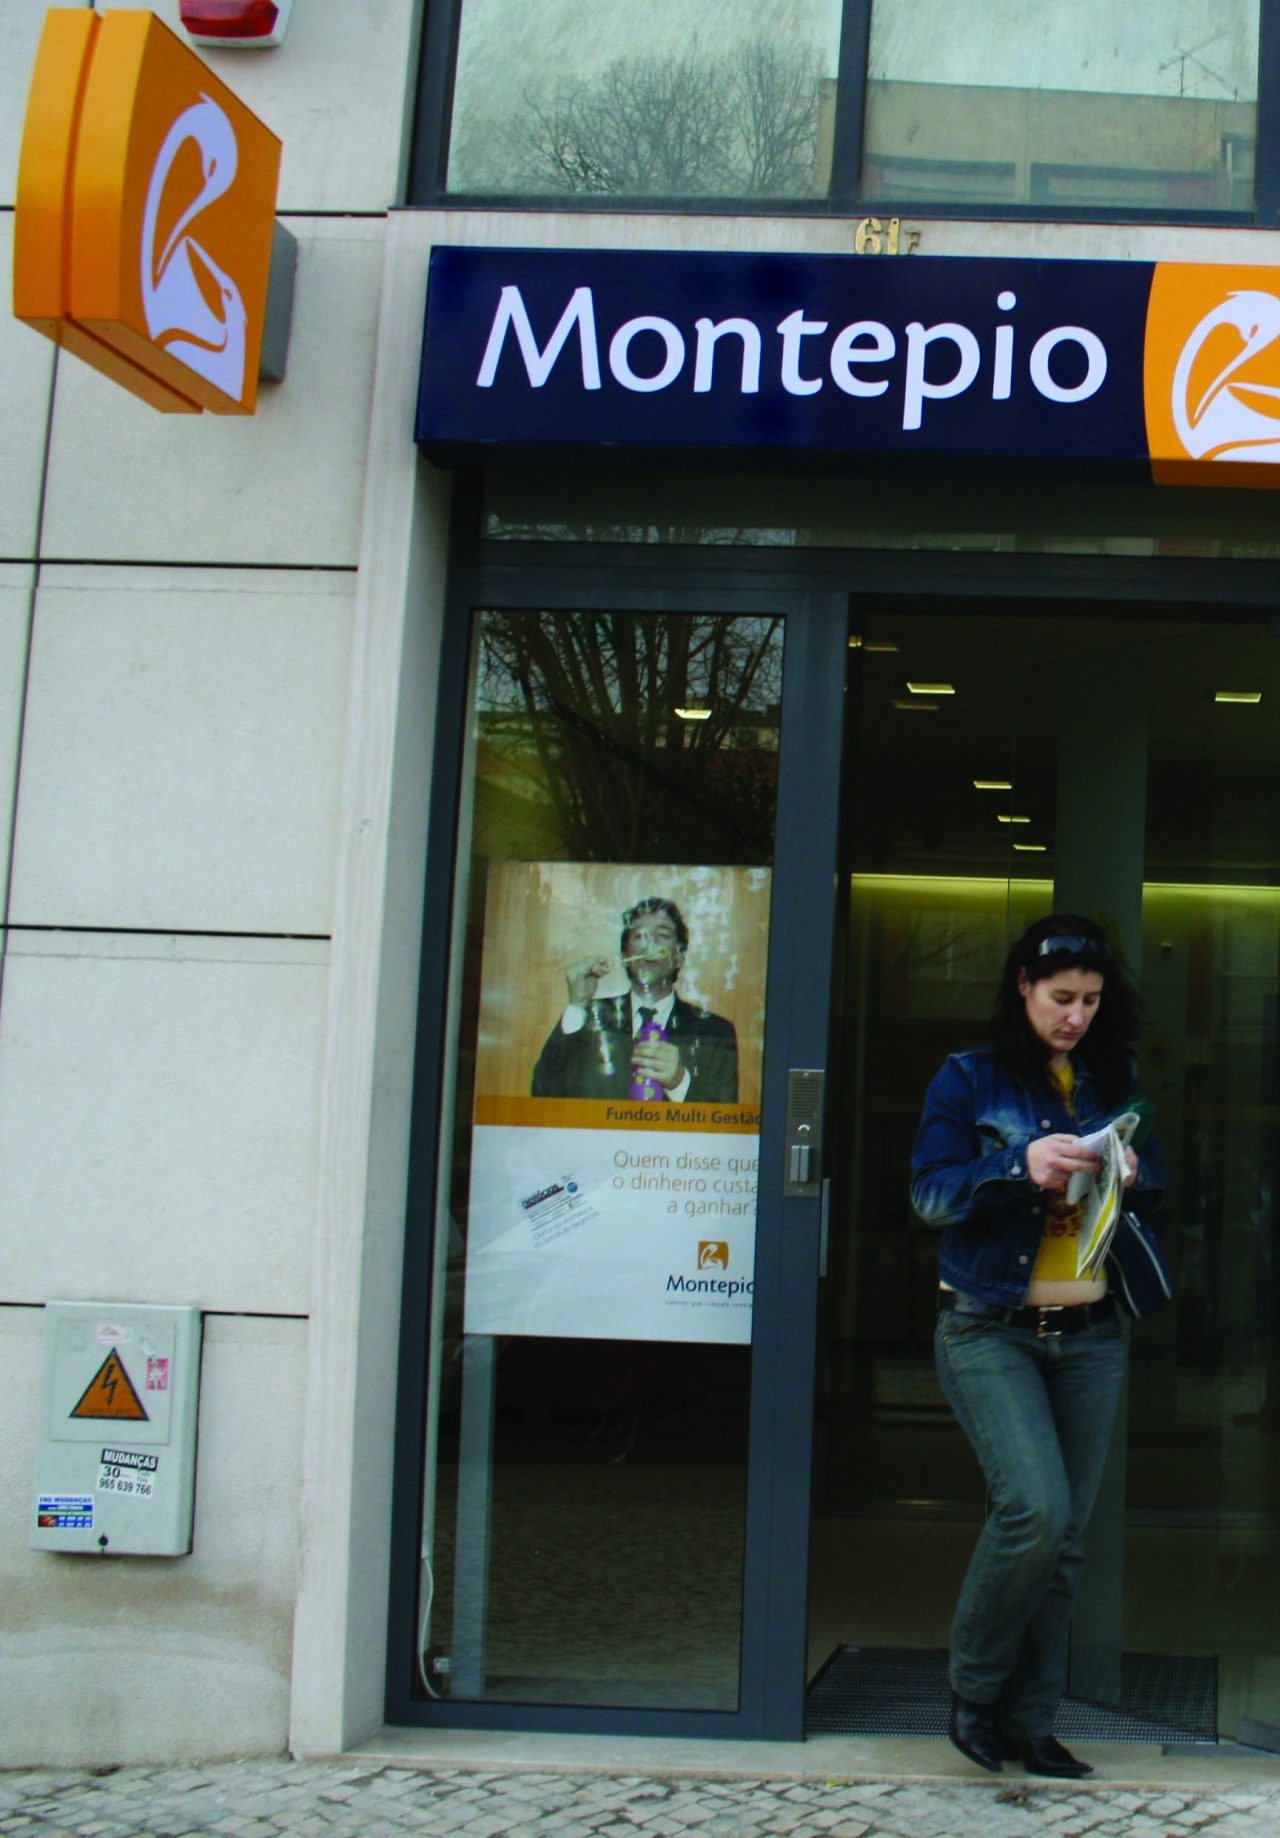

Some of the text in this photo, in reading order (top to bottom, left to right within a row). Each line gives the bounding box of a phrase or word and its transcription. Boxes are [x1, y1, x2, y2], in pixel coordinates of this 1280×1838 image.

[476, 284, 1109, 431] Montepio
[606, 1107, 660, 1122] Fundos
[666, 1109, 706, 1123] Multi
[614, 1150, 759, 1176] Quem disse que
[612, 1175, 624, 1189] o
[630, 1172, 707, 1193] dinheiro
[667, 1200, 677, 1214] a
[103, 1450, 156, 1470] MUDANÇAS
[103, 1465, 121, 1479] 30
